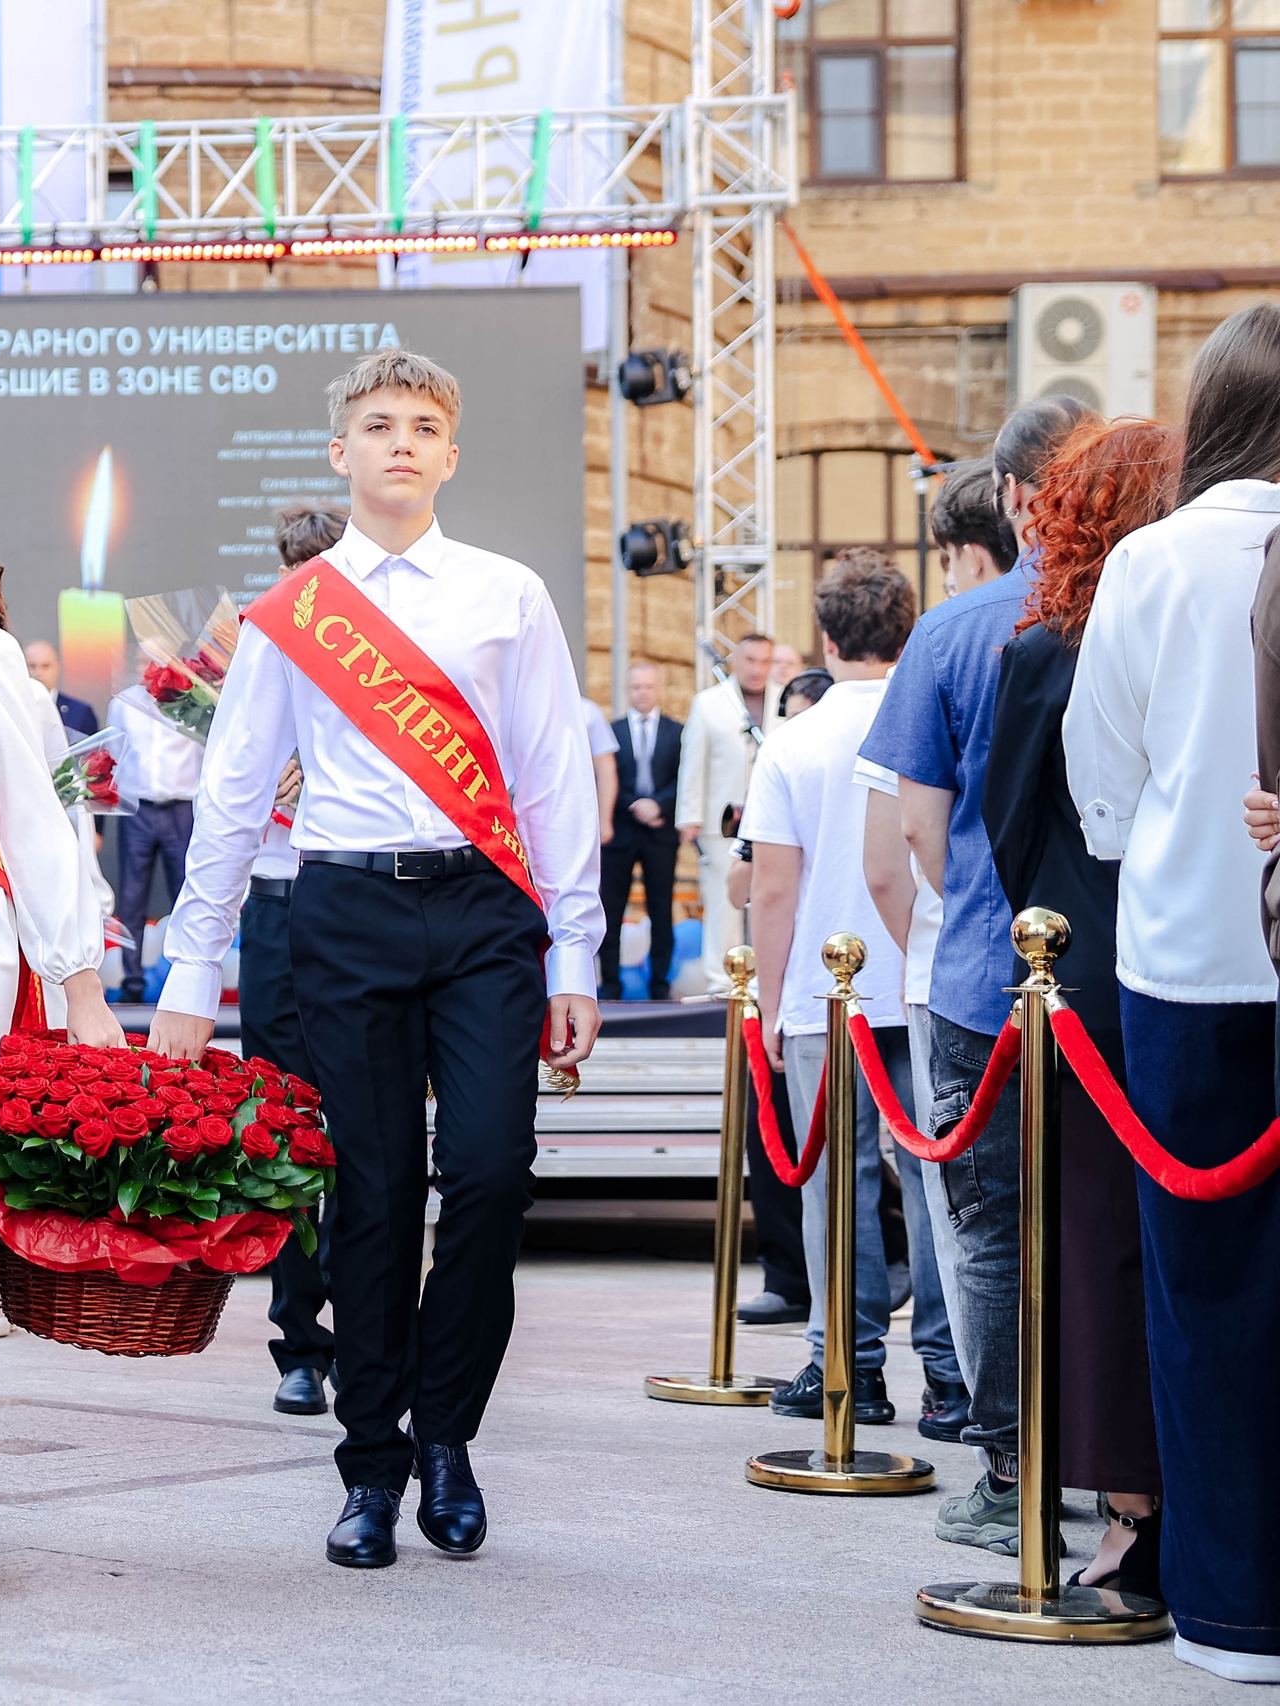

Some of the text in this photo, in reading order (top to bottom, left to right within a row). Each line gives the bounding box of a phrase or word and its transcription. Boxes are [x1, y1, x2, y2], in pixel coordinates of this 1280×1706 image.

[147, 322, 403, 355] УНИВЕРСИТЕТА
[88, 366, 110, 396] В
[116, 364, 203, 396] ЗОНЕ
[209, 363, 279, 395] СВО
[314, 614, 491, 803] СТУДЕНТ
